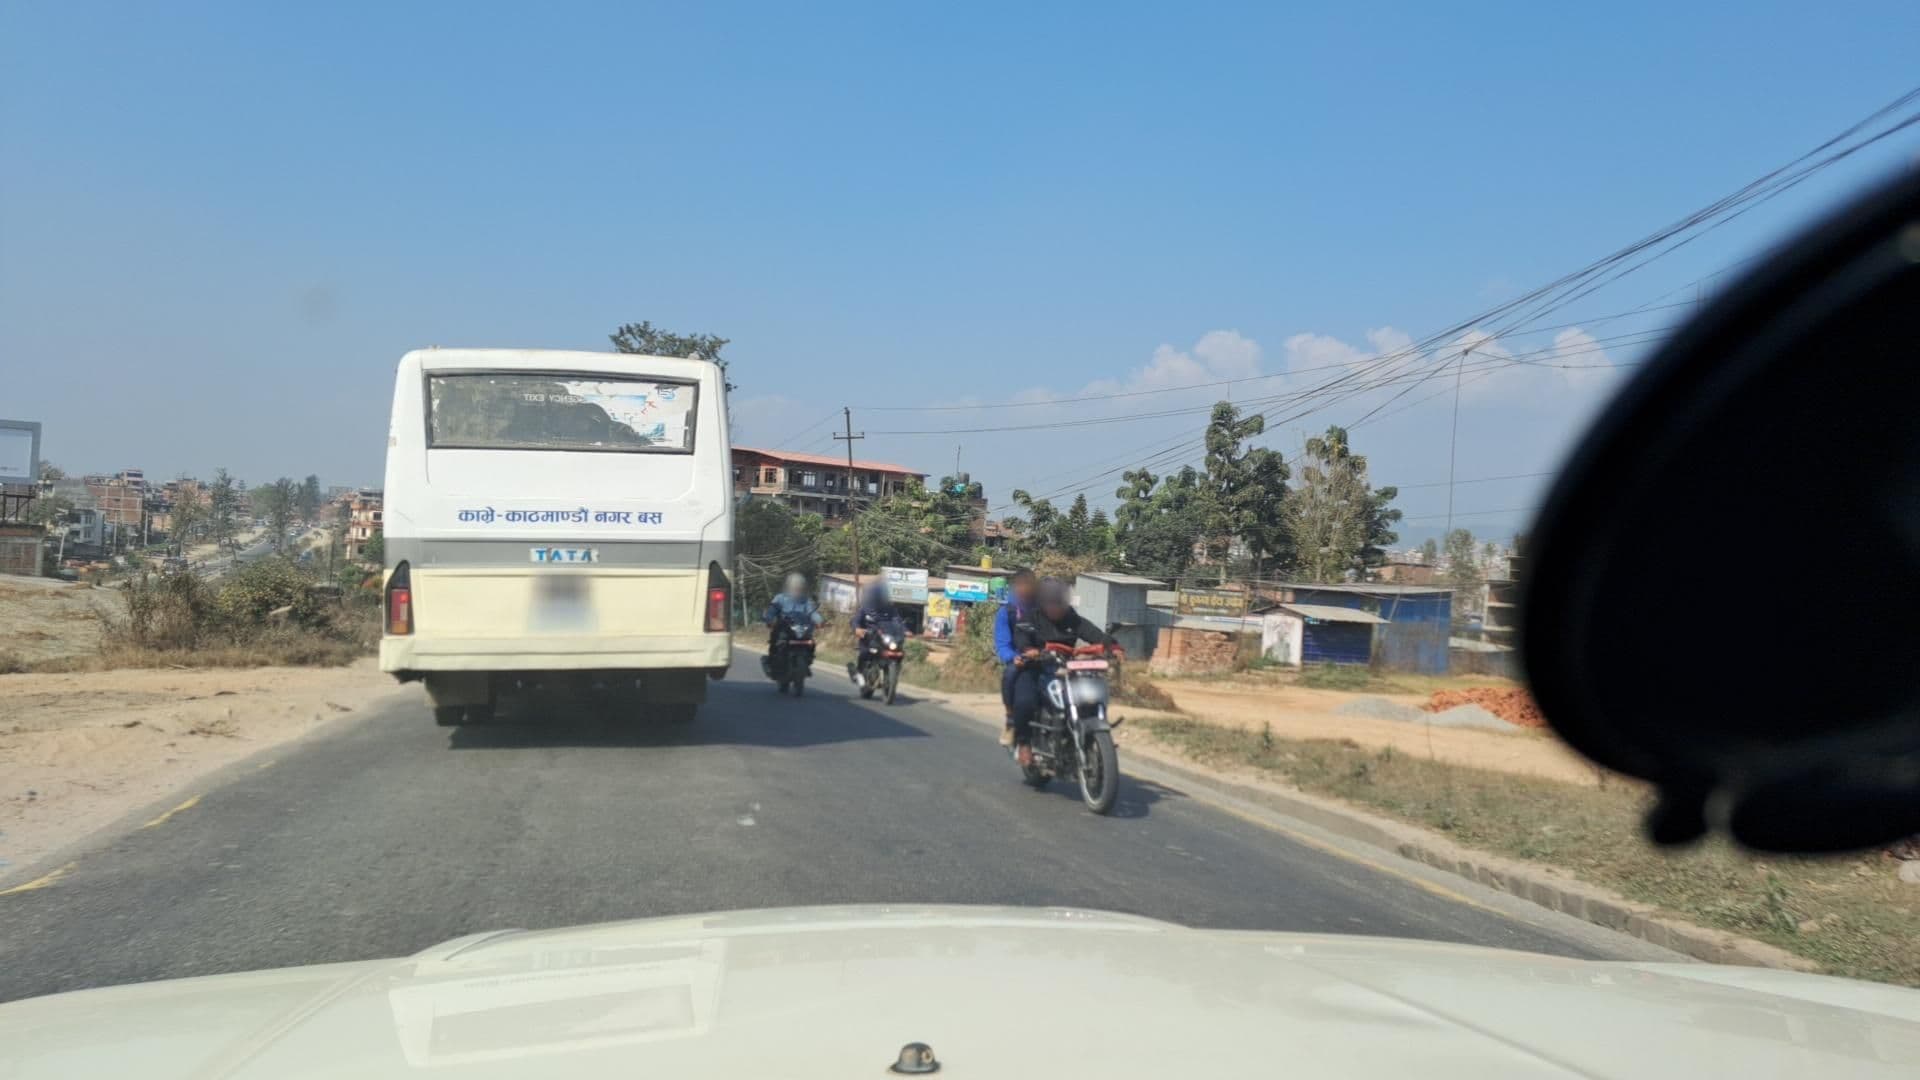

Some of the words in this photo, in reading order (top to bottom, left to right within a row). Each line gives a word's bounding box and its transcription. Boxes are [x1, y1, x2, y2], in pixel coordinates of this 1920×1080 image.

[594, 511, 633, 525] नगर
[638, 511, 663, 525] बस
[535, 549, 592, 561] TATA
